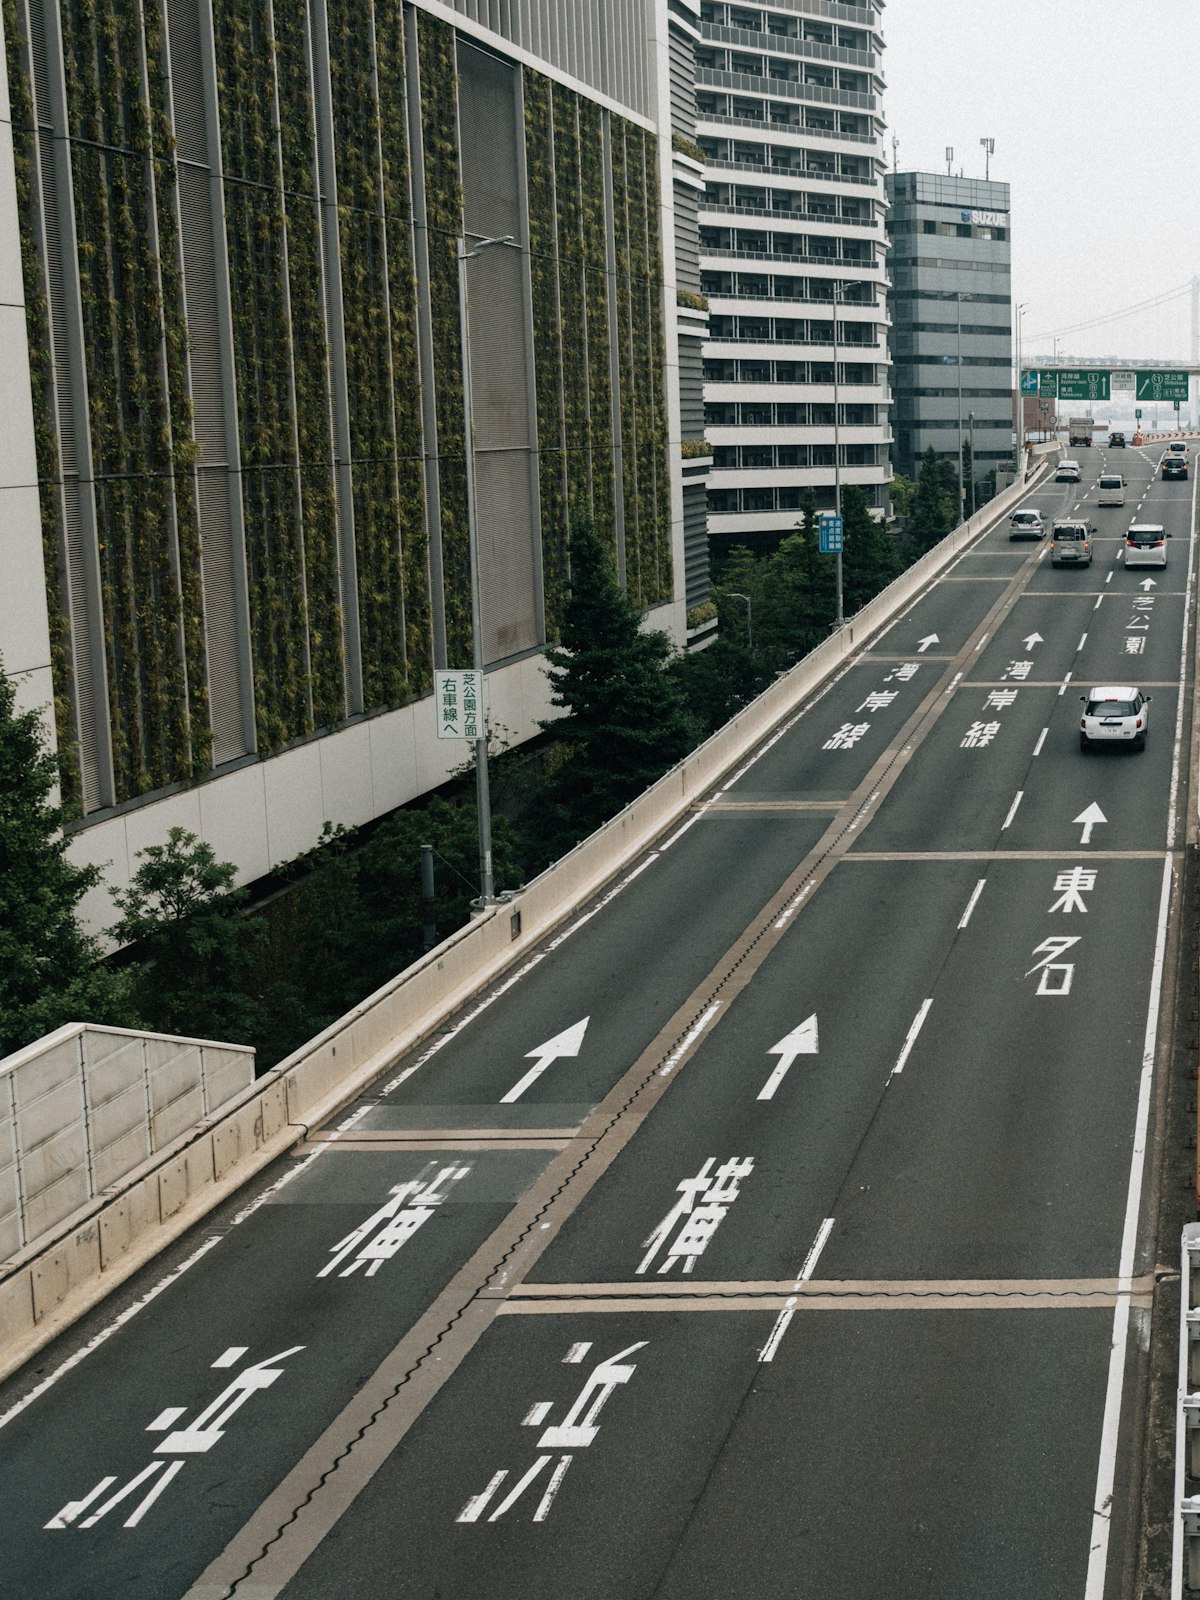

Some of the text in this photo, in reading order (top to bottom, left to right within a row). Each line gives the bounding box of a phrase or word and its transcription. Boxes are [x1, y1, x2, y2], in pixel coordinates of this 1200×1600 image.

[971, 210, 1006, 226] SUZUE
[442, 678, 458, 734] 右車線へ
[463, 673, 477, 737] 芝公園方面
[822, 661, 922, 749] 湾岸線
[960, 661, 1034, 748] 湾岸線
[1025, 866, 1098, 996] 東名
[43, 1160, 470, 1529] 横浜
[455, 1156, 754, 1523] 横浜
